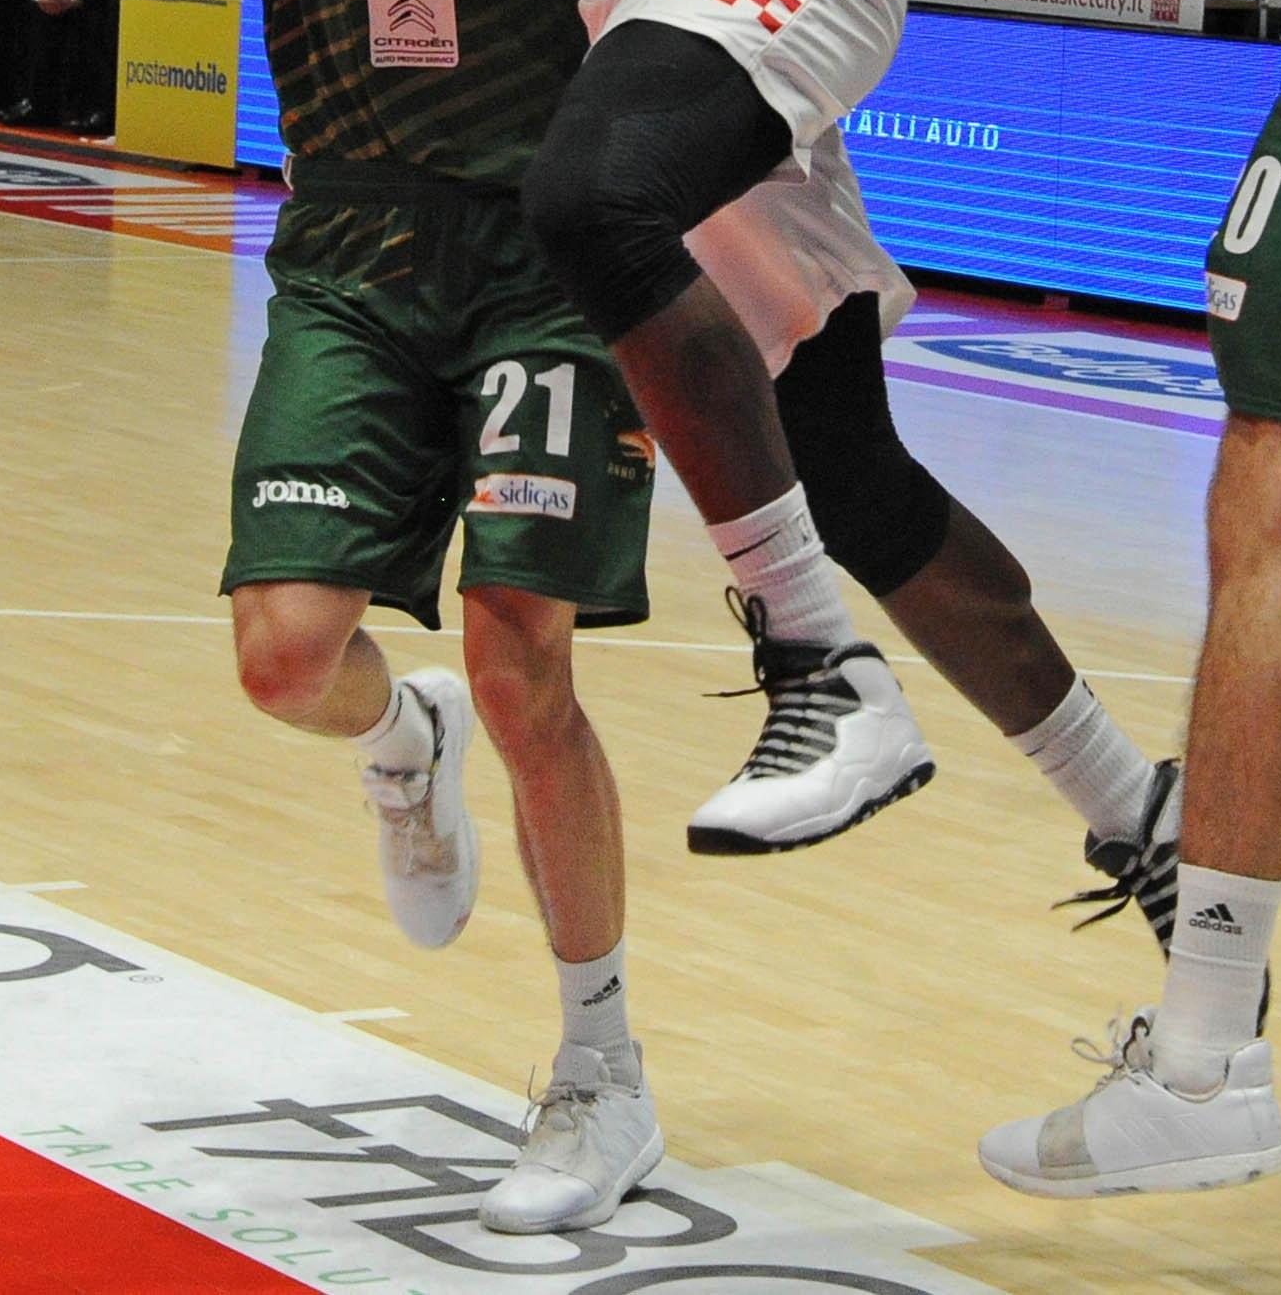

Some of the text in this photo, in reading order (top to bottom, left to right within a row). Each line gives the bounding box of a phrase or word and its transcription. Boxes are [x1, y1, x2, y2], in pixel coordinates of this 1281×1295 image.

[374, 55, 396, 64] AUTO
[126, 61, 227, 94] postemobile
[926, 118, 1000, 151] AUTO
[479, 360, 575, 457] 21
[1189, 917, 1243, 936] adidas
[19, 1122, 430, 1295] TAPE SOLU
[142, 1094, 936, 1295] FAB
